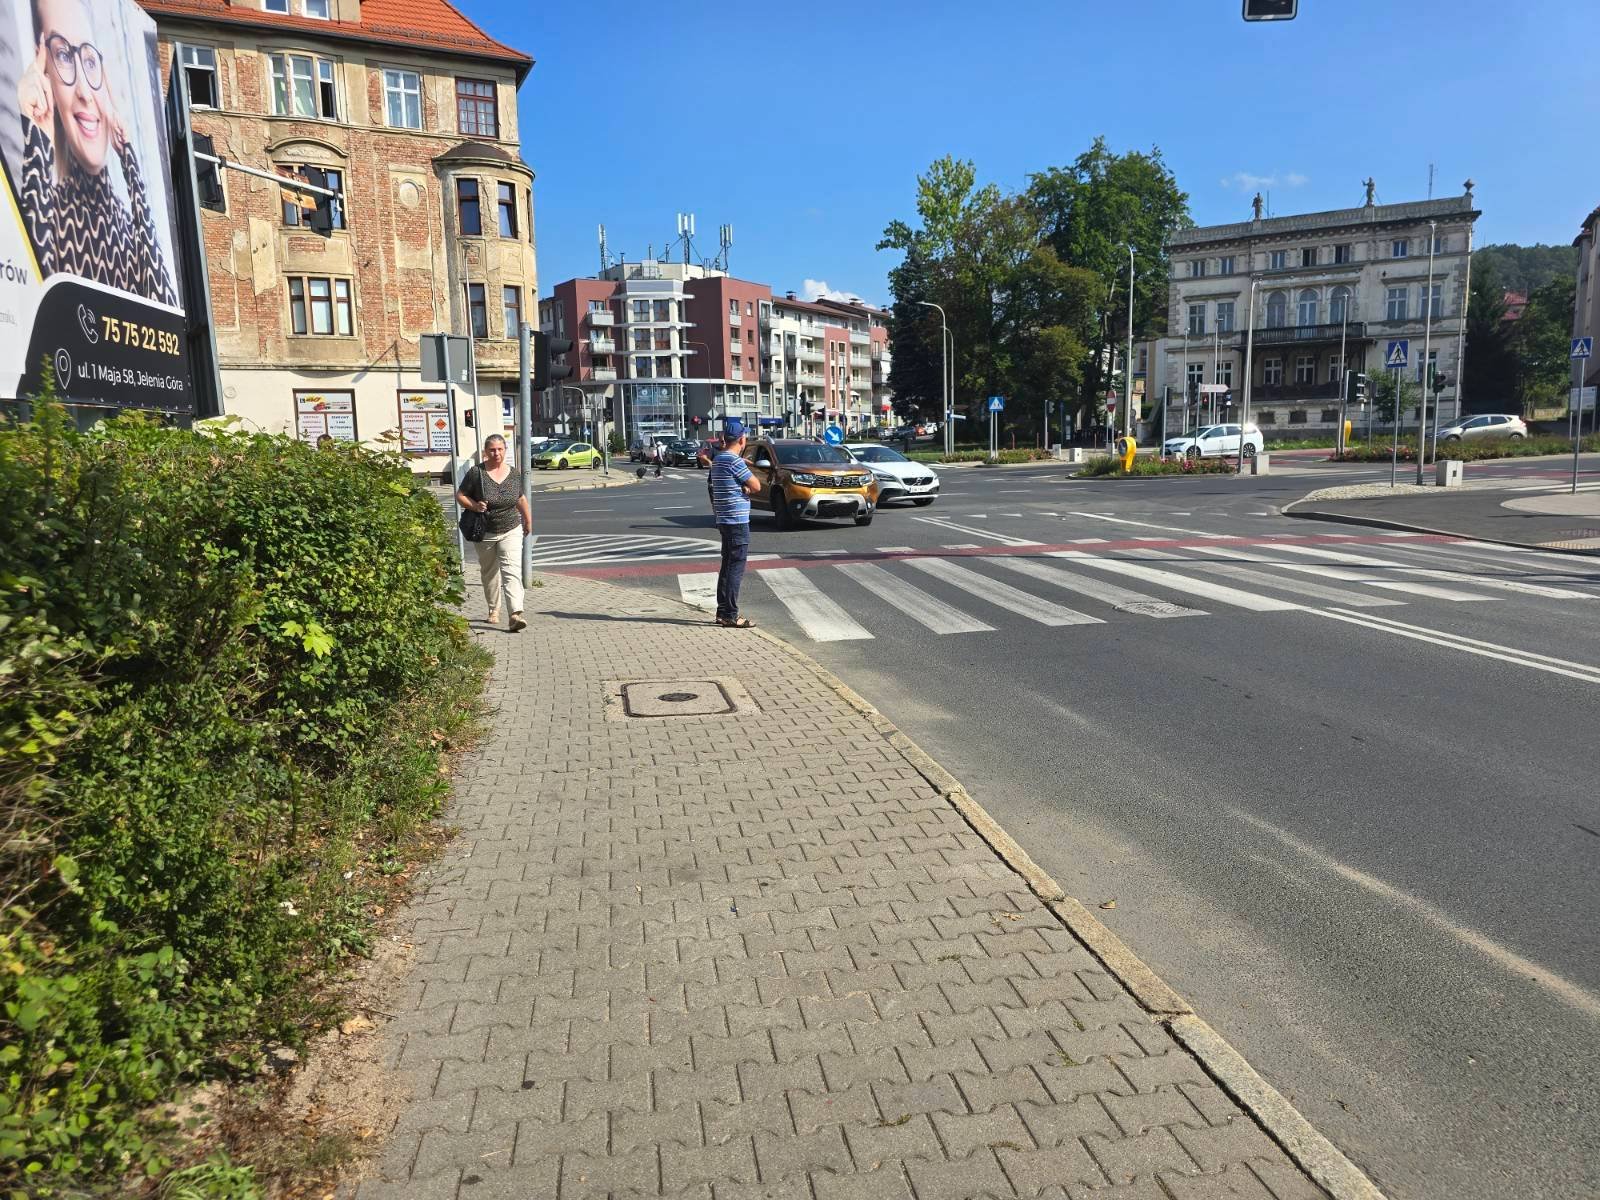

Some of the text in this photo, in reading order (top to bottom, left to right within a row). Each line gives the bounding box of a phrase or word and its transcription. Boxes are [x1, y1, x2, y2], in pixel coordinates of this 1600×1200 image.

[101, 315, 180, 356] 75 75 22 592
[78, 361, 183, 391] ul. 1 Maja 58, Jelenia Góra
